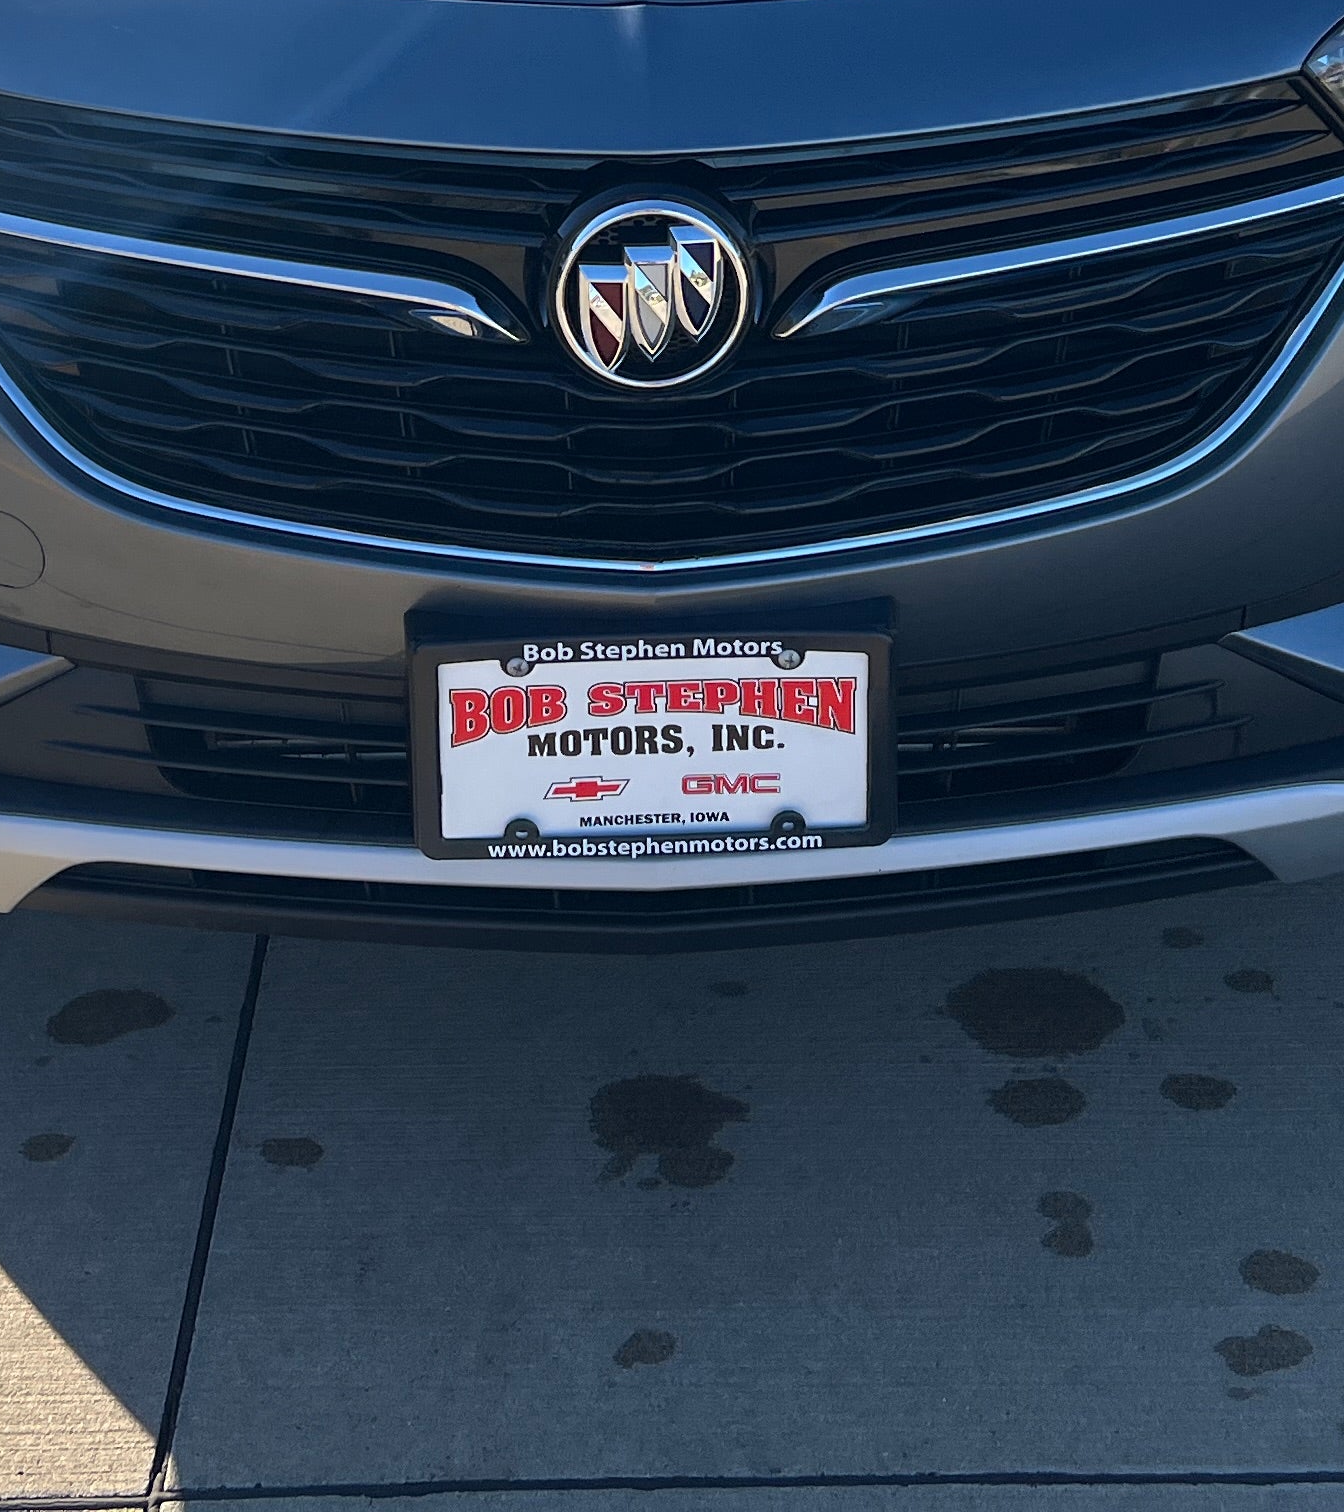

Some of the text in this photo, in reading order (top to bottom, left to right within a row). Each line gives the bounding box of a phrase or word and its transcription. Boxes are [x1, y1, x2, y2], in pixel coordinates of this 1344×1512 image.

[523, 638, 784, 662] Bob Stephen Motors
[449, 677, 856, 748] BOB STEPHEN
[528, 725, 785, 757] MOTORS, INC.
[681, 773, 781, 794] GMC
[579, 811, 730, 828] MANCHESTER, IOWA
[488, 833, 823, 859] www.bobstephenmotors.com
